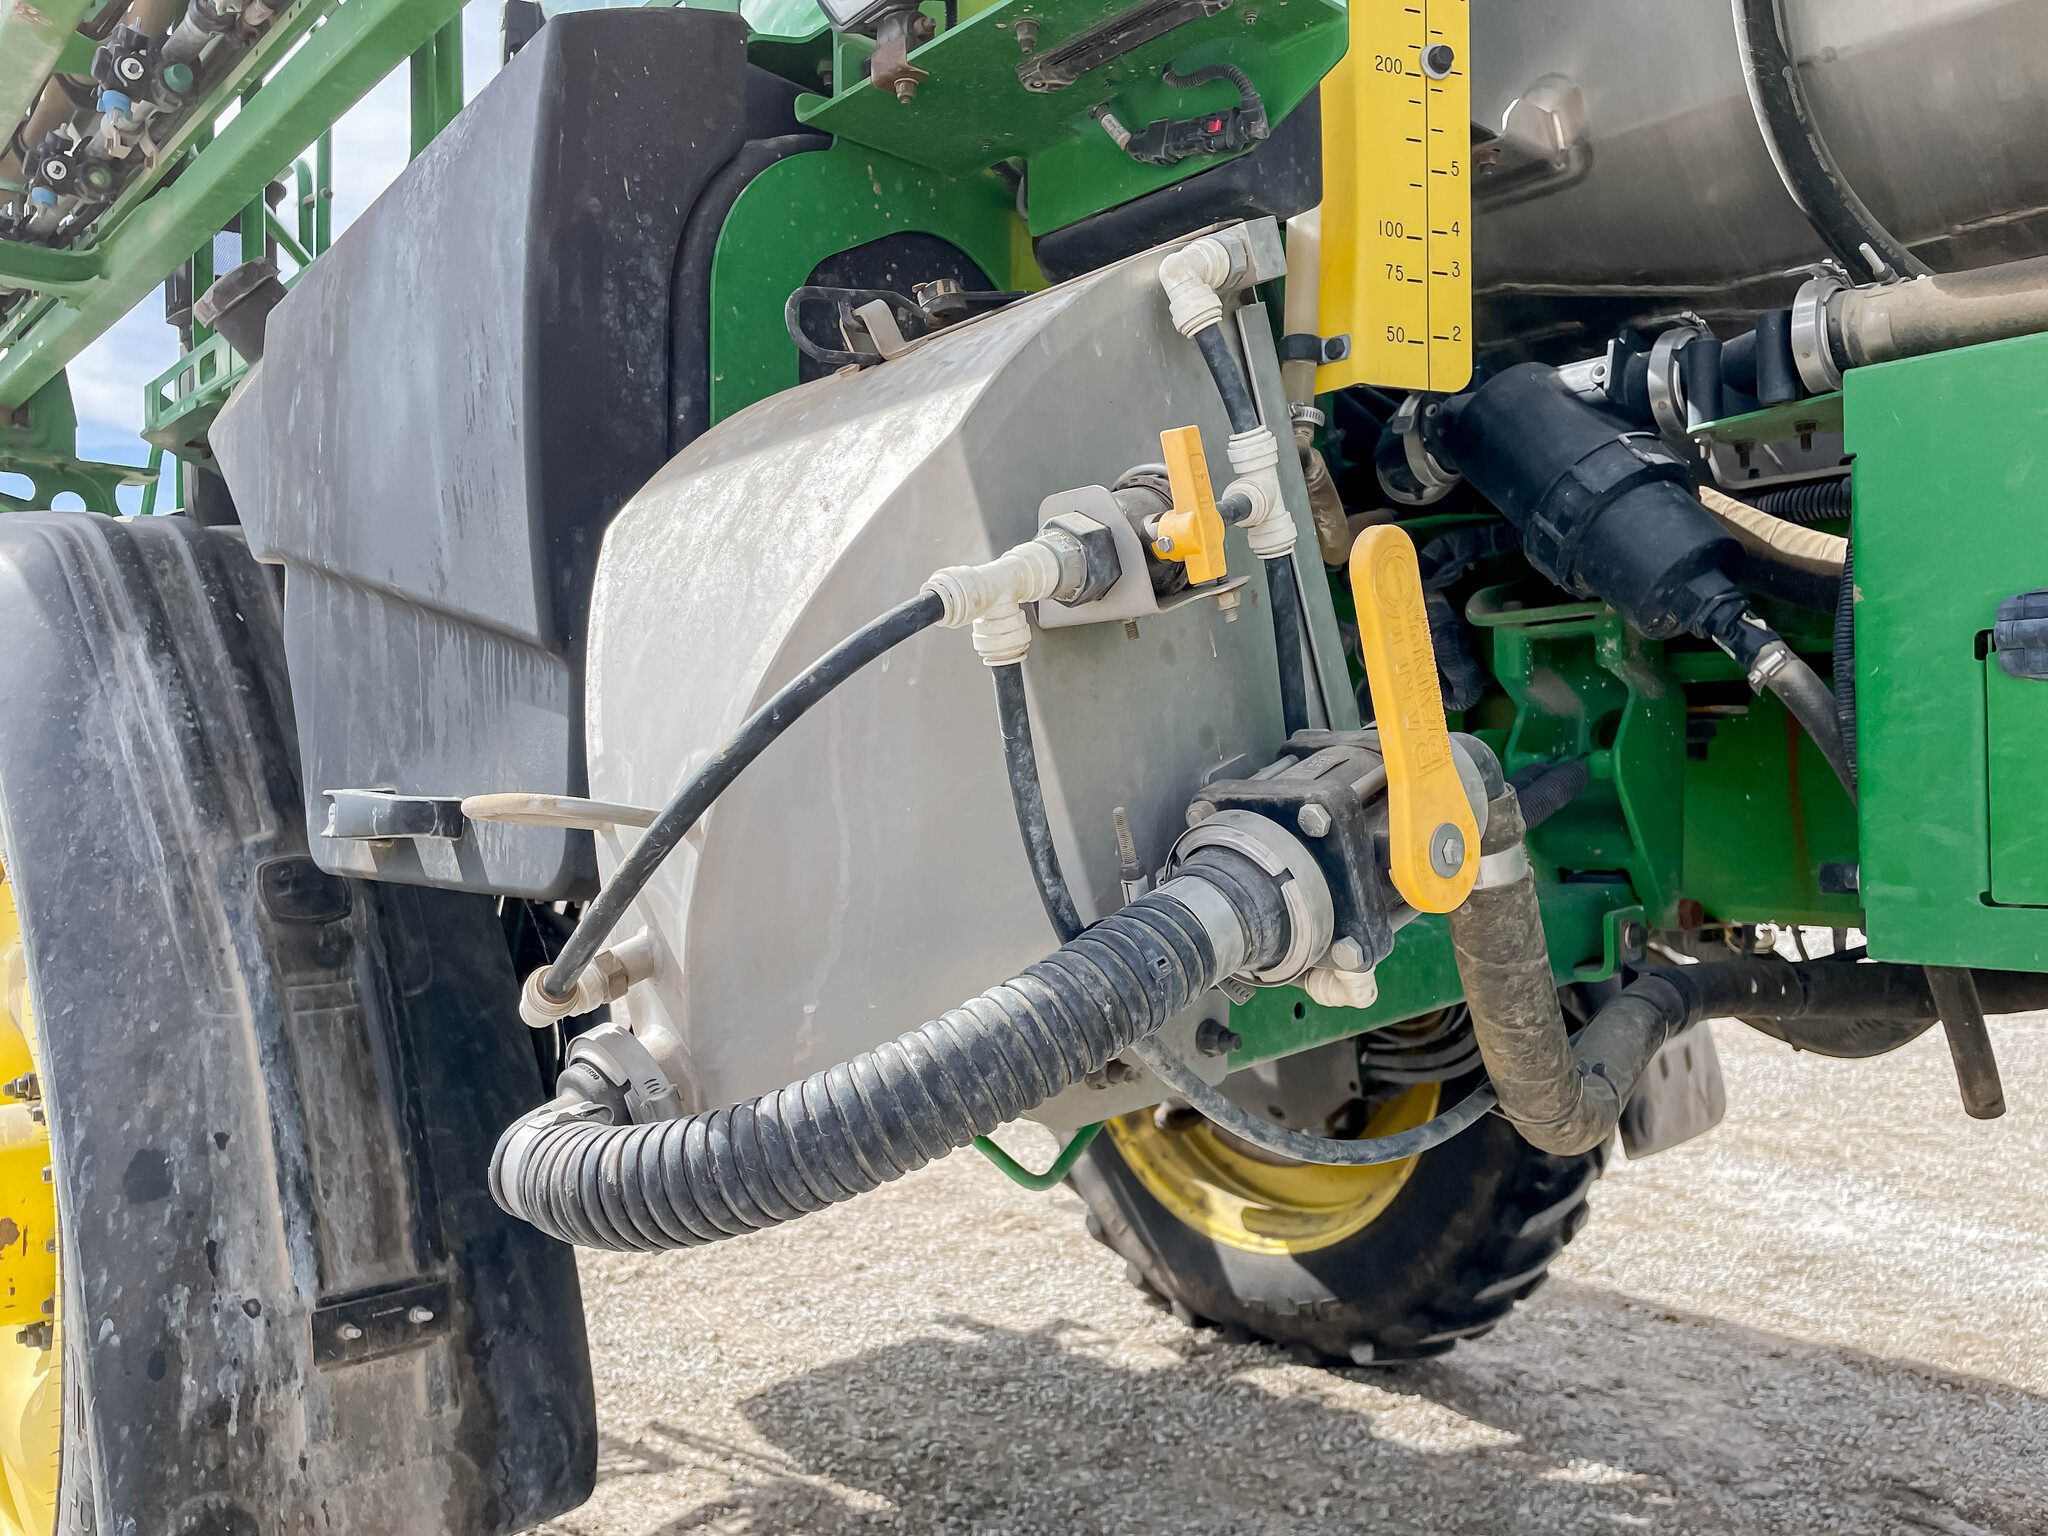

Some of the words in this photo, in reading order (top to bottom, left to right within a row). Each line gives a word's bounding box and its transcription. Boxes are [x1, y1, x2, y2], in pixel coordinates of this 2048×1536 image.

[1374, 54, 1403, 75] 200
[1450, 160, 1460, 177] 5
[1379, 219, 1404, 239] 100
[1451, 220, 1460, 237] 4
[1385, 263, 1404, 282] 75
[1451, 260, 1461, 278] 3
[1386, 326, 1405, 343] 50
[1452, 326, 1462, 343] 2
